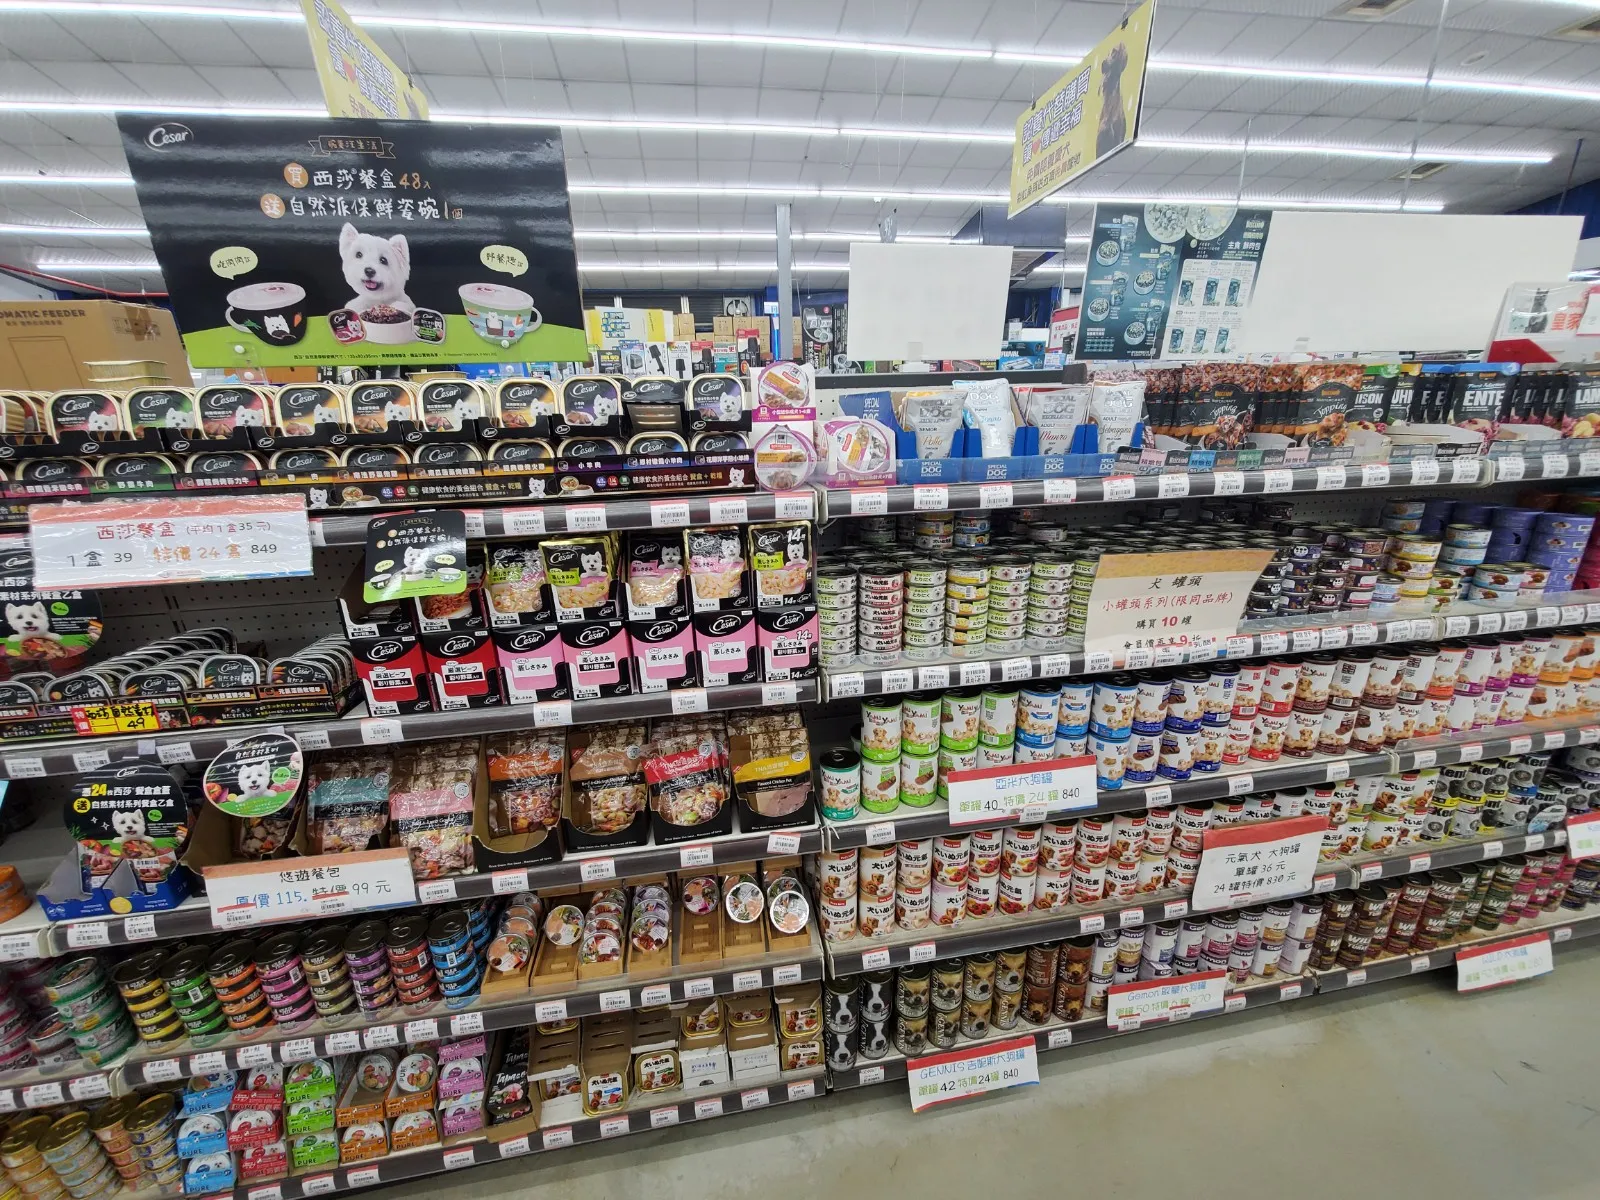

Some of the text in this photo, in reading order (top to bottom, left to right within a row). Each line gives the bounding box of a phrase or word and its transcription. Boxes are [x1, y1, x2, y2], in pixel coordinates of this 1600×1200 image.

[148, 127, 188, 147] Cesar
[287, 166, 304, 185] 買
[42, 309, 86, 318] FEEDER
[431, 388, 460, 401] Cesar
[572, 384, 599, 396] Cesar
[700, 382, 724, 394] Cesar
[140, 396, 170, 409] Cesar
[210, 394, 241, 406] Cesar
[289, 393, 318, 406] Cesar
[361, 390, 390, 402] Cesar
[1462, 390, 1505, 406] ENTE
[62, 400, 92, 415] Cesar
[919, 408, 952, 418] DOG
[1043, 404, 1076, 414] DOG
[1209, 403, 1238, 420] Topping
[1312, 402, 1348, 419] Topping
[571, 444, 597, 456] Cesar
[639, 441, 663, 453] Cesar
[703, 439, 727, 451] Cesar
[356, 449, 386, 463] Cesar
[429, 446, 456, 459] Cesar
[115, 462, 147, 475] Cesar
[203, 458, 232, 472] Cesar
[286, 456, 315, 469] Cesar
[35, 465, 66, 478] Cesar
[920, 466, 942, 474] DOG
[987, 469, 1007, 477] DOG
[97, 521, 177, 540] 西莎餐盒
[113, 552, 133, 563] 39
[250, 543, 278, 554] 849
[1148, 575, 1204, 590] 犬 罐頭
[713, 617, 740, 633] Cesar
[776, 613, 803, 629] Cesar
[1136, 615, 1192, 629] 購買 10 罐
[580, 629, 608, 645] Cesar
[650, 623, 676, 639] Cesar
[443, 638, 472, 655] Cesar
[514, 632, 543, 649] Cesar
[776, 640, 803, 649] 蒸しささみ
[370, 644, 401, 662] Cesar
[650, 652, 679, 662] 蒸しささみ
[713, 646, 742, 656] 蒸しささみ
[582, 654, 611, 664] 蒸しささみ
[517, 662, 548, 672] 蒸しささみ
[126, 717, 146, 730] 49
[116, 768, 138, 778] Cesar
[996, 772, 1053, 790] 亞米大狗罐
[76, 798, 175, 811] 送 自然素材系列餐盒乙盒
[959, 787, 1080, 813] 單罐 40 840
[1225, 843, 1301, 864] 元氣犬 大狗罐
[279, 867, 341, 883] 悠遊餐包
[1235, 860, 1287, 877] 單罐 36 元
[352, 882, 370, 894] 99
[375, 879, 392, 894] 元
[1213, 883, 1226, 894] 24
[1266, 874, 1285, 885] 830
[1286, 871, 1297, 882] 元
[1127, 990, 1160, 1002] Gemon
[1136, 1003, 1150, 1014] 50
[920, 1061, 965, 1080] GENNIS
[940, 1080, 956, 1092] 42
[1003, 1068, 1019, 1080] 840
